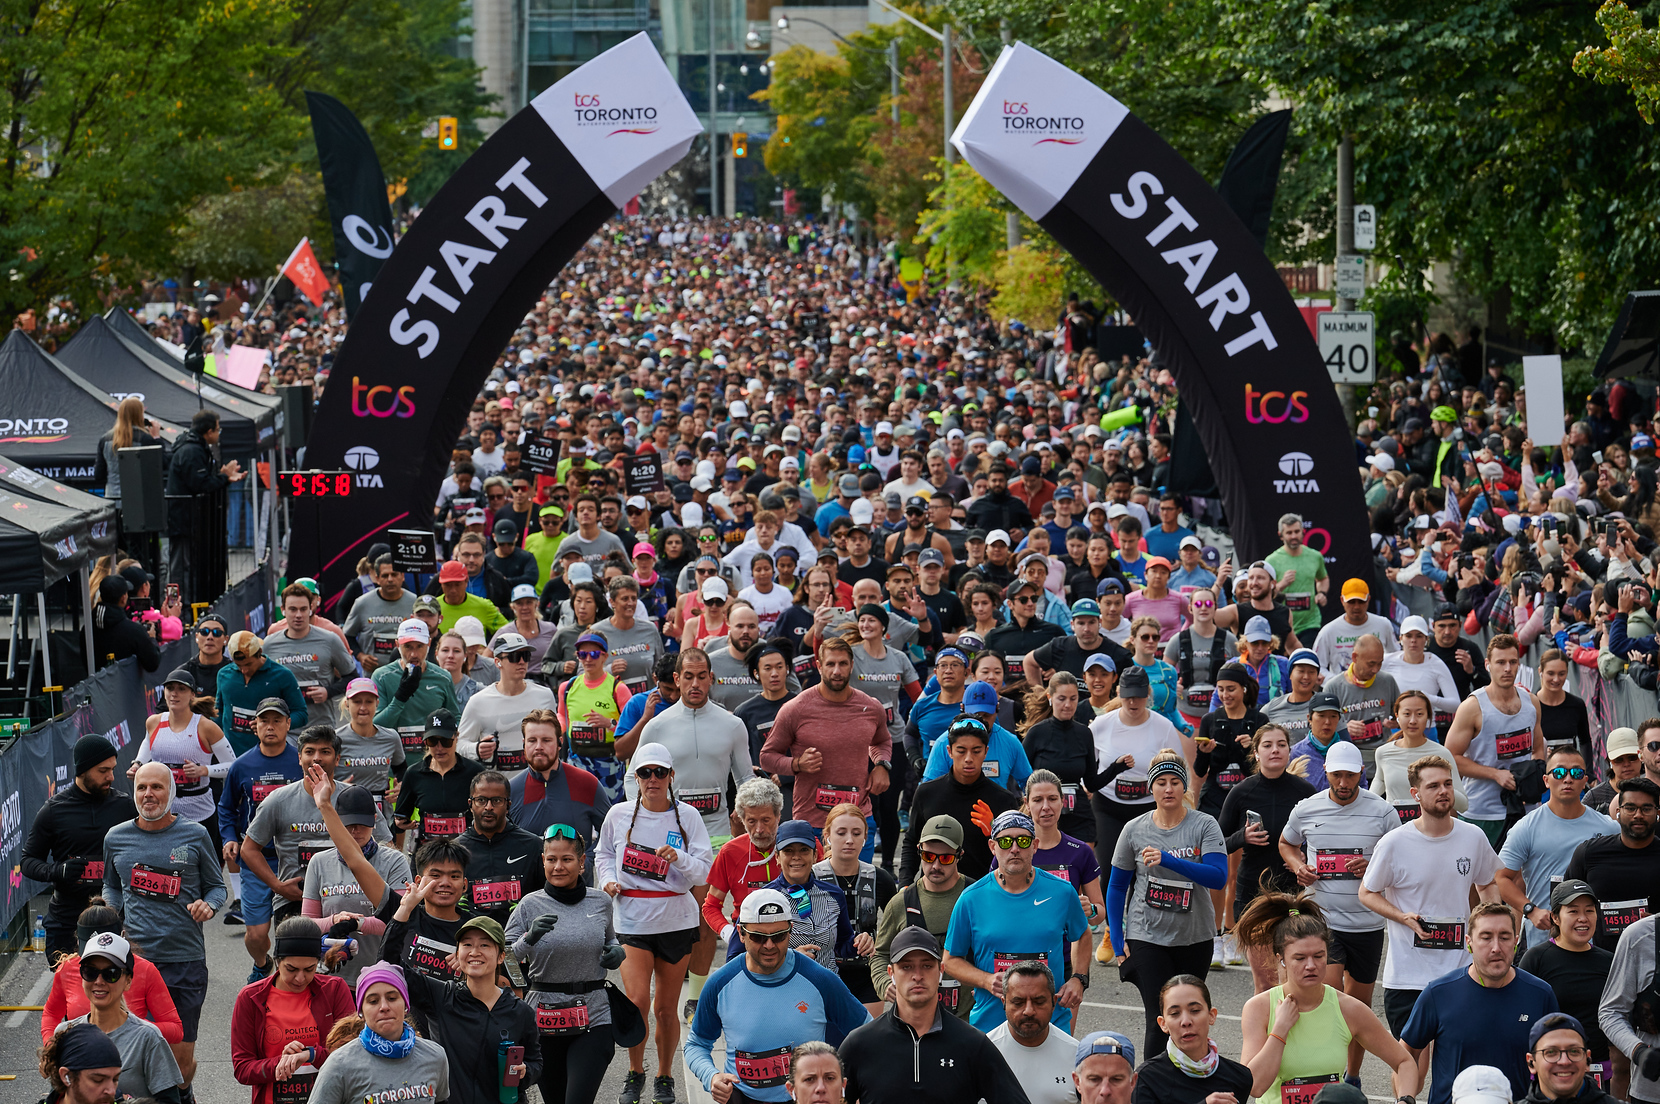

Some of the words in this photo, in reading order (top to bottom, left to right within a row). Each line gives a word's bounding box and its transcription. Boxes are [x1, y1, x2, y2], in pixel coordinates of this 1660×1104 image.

[575, 92, 600, 107] tcs
[1004, 99, 1028, 114] tcs
[574, 107, 658, 121] TORONTO
[1003, 117, 1084, 130] TORONTO
[389, 156, 549, 359] START
[1110, 171, 1278, 357] START
[1324, 322, 1368, 333] MAXIMUM
[1325, 343, 1369, 374] 40
[352, 376, 416, 418] tcs
[1245, 382, 1309, 424] tcs
[528, 444, 554, 458] 2:10
[65, 466, 95, 478] MAR
[630, 464, 656, 477] 4:20
[291, 474, 351, 495] 9:15:18
[1273, 480, 1320, 493] TATA
[397, 543, 427, 555] 2:10
[371, 616, 403, 625] TORONTO
[615, 645, 647, 656] TORONTO
[278, 653, 312, 664] TORONTO
[863, 674, 896, 682] TORONTO
[595, 701, 610, 710] QRC
[1347, 702, 1381, 713] TORONTO
[433, 716, 442, 727] LA
[402, 737, 423, 745] 18305
[572, 732, 592, 740] 15370
[1499, 742, 1520, 752] 3904
[350, 757, 388, 767] TORONTO
[1218, 774, 1240, 782] 13809
[1117, 785, 1140, 793] 10019
[819, 796, 843, 804] 2327
[428, 824, 449, 832] 1574
[667, 836, 682, 847] 10K
[625, 856, 650, 869] 2023
[1319, 862, 1336, 871] 693
[134, 877, 159, 890] 5236
[476, 892, 501, 901] 2516
[1149, 889, 1174, 901] 16189
[762, 905, 778, 914] NB
[1604, 916, 1630, 925] 14518
[418, 946, 436, 955] AARON
[416, 953, 446, 969] 10906
[539, 1017, 567, 1026] 4678
[1518, 1013, 1529, 1022] NB
[285, 1026, 319, 1035] POLITECN
[740, 1067, 769, 1077] 4311
[276, 1083, 308, 1094] 15481
[373, 1085, 428, 1104] TORONTO
